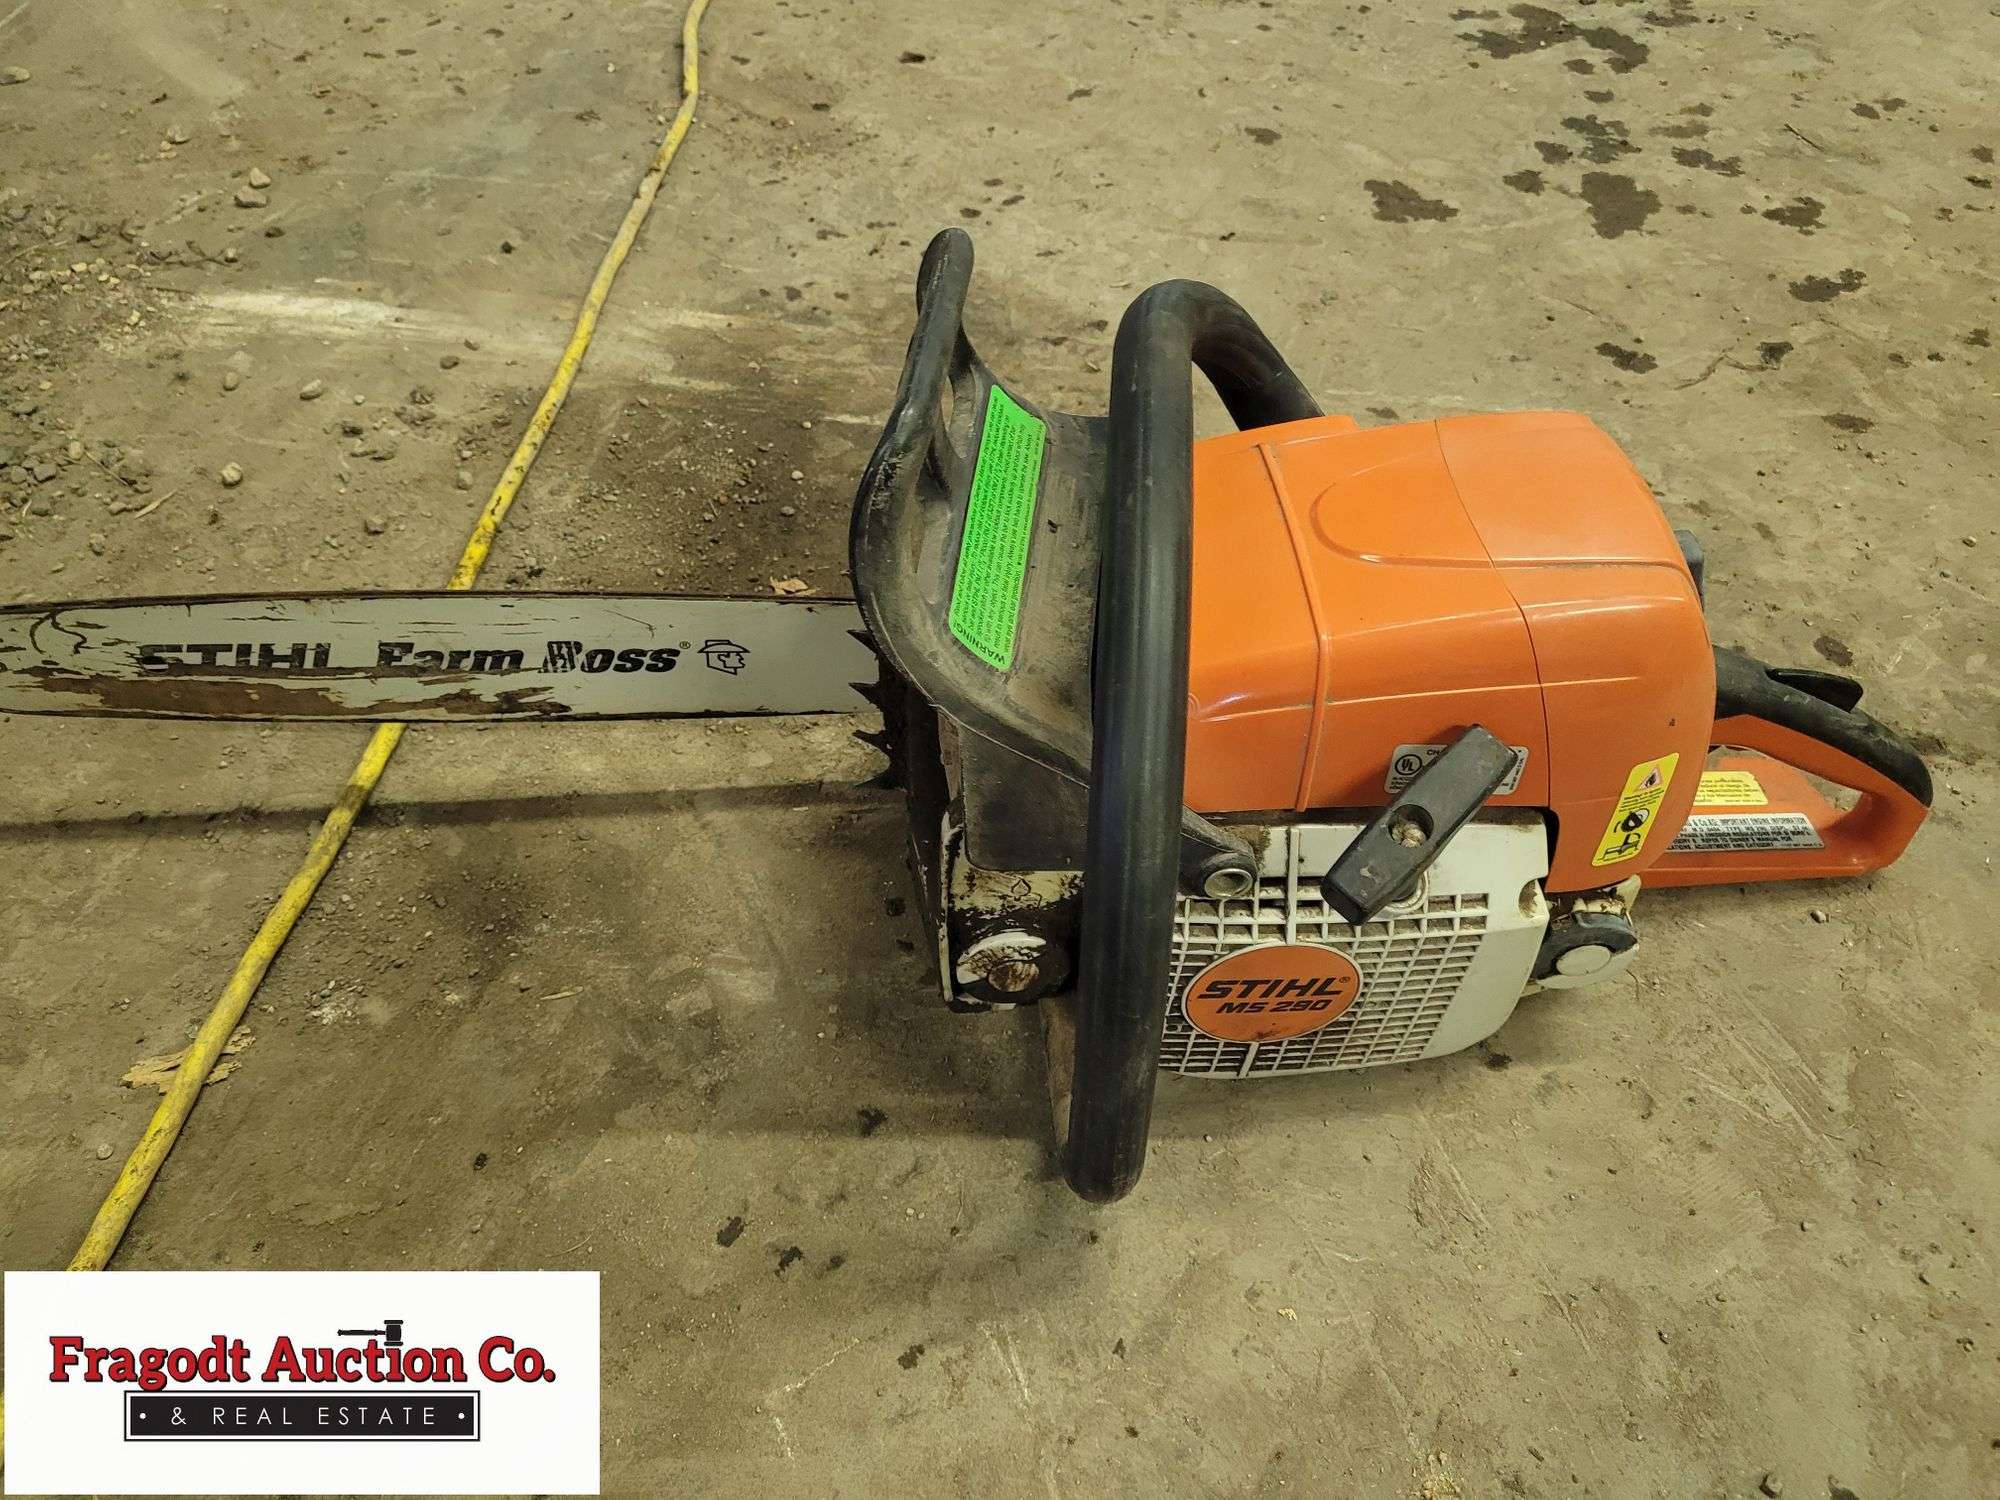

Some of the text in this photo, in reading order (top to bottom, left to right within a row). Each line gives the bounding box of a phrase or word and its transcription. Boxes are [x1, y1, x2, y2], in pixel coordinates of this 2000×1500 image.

[376, 642, 525, 674] Farm
[1197, 977, 1342, 999] STIHL
[1216, 999, 1333, 1014] MS 290
